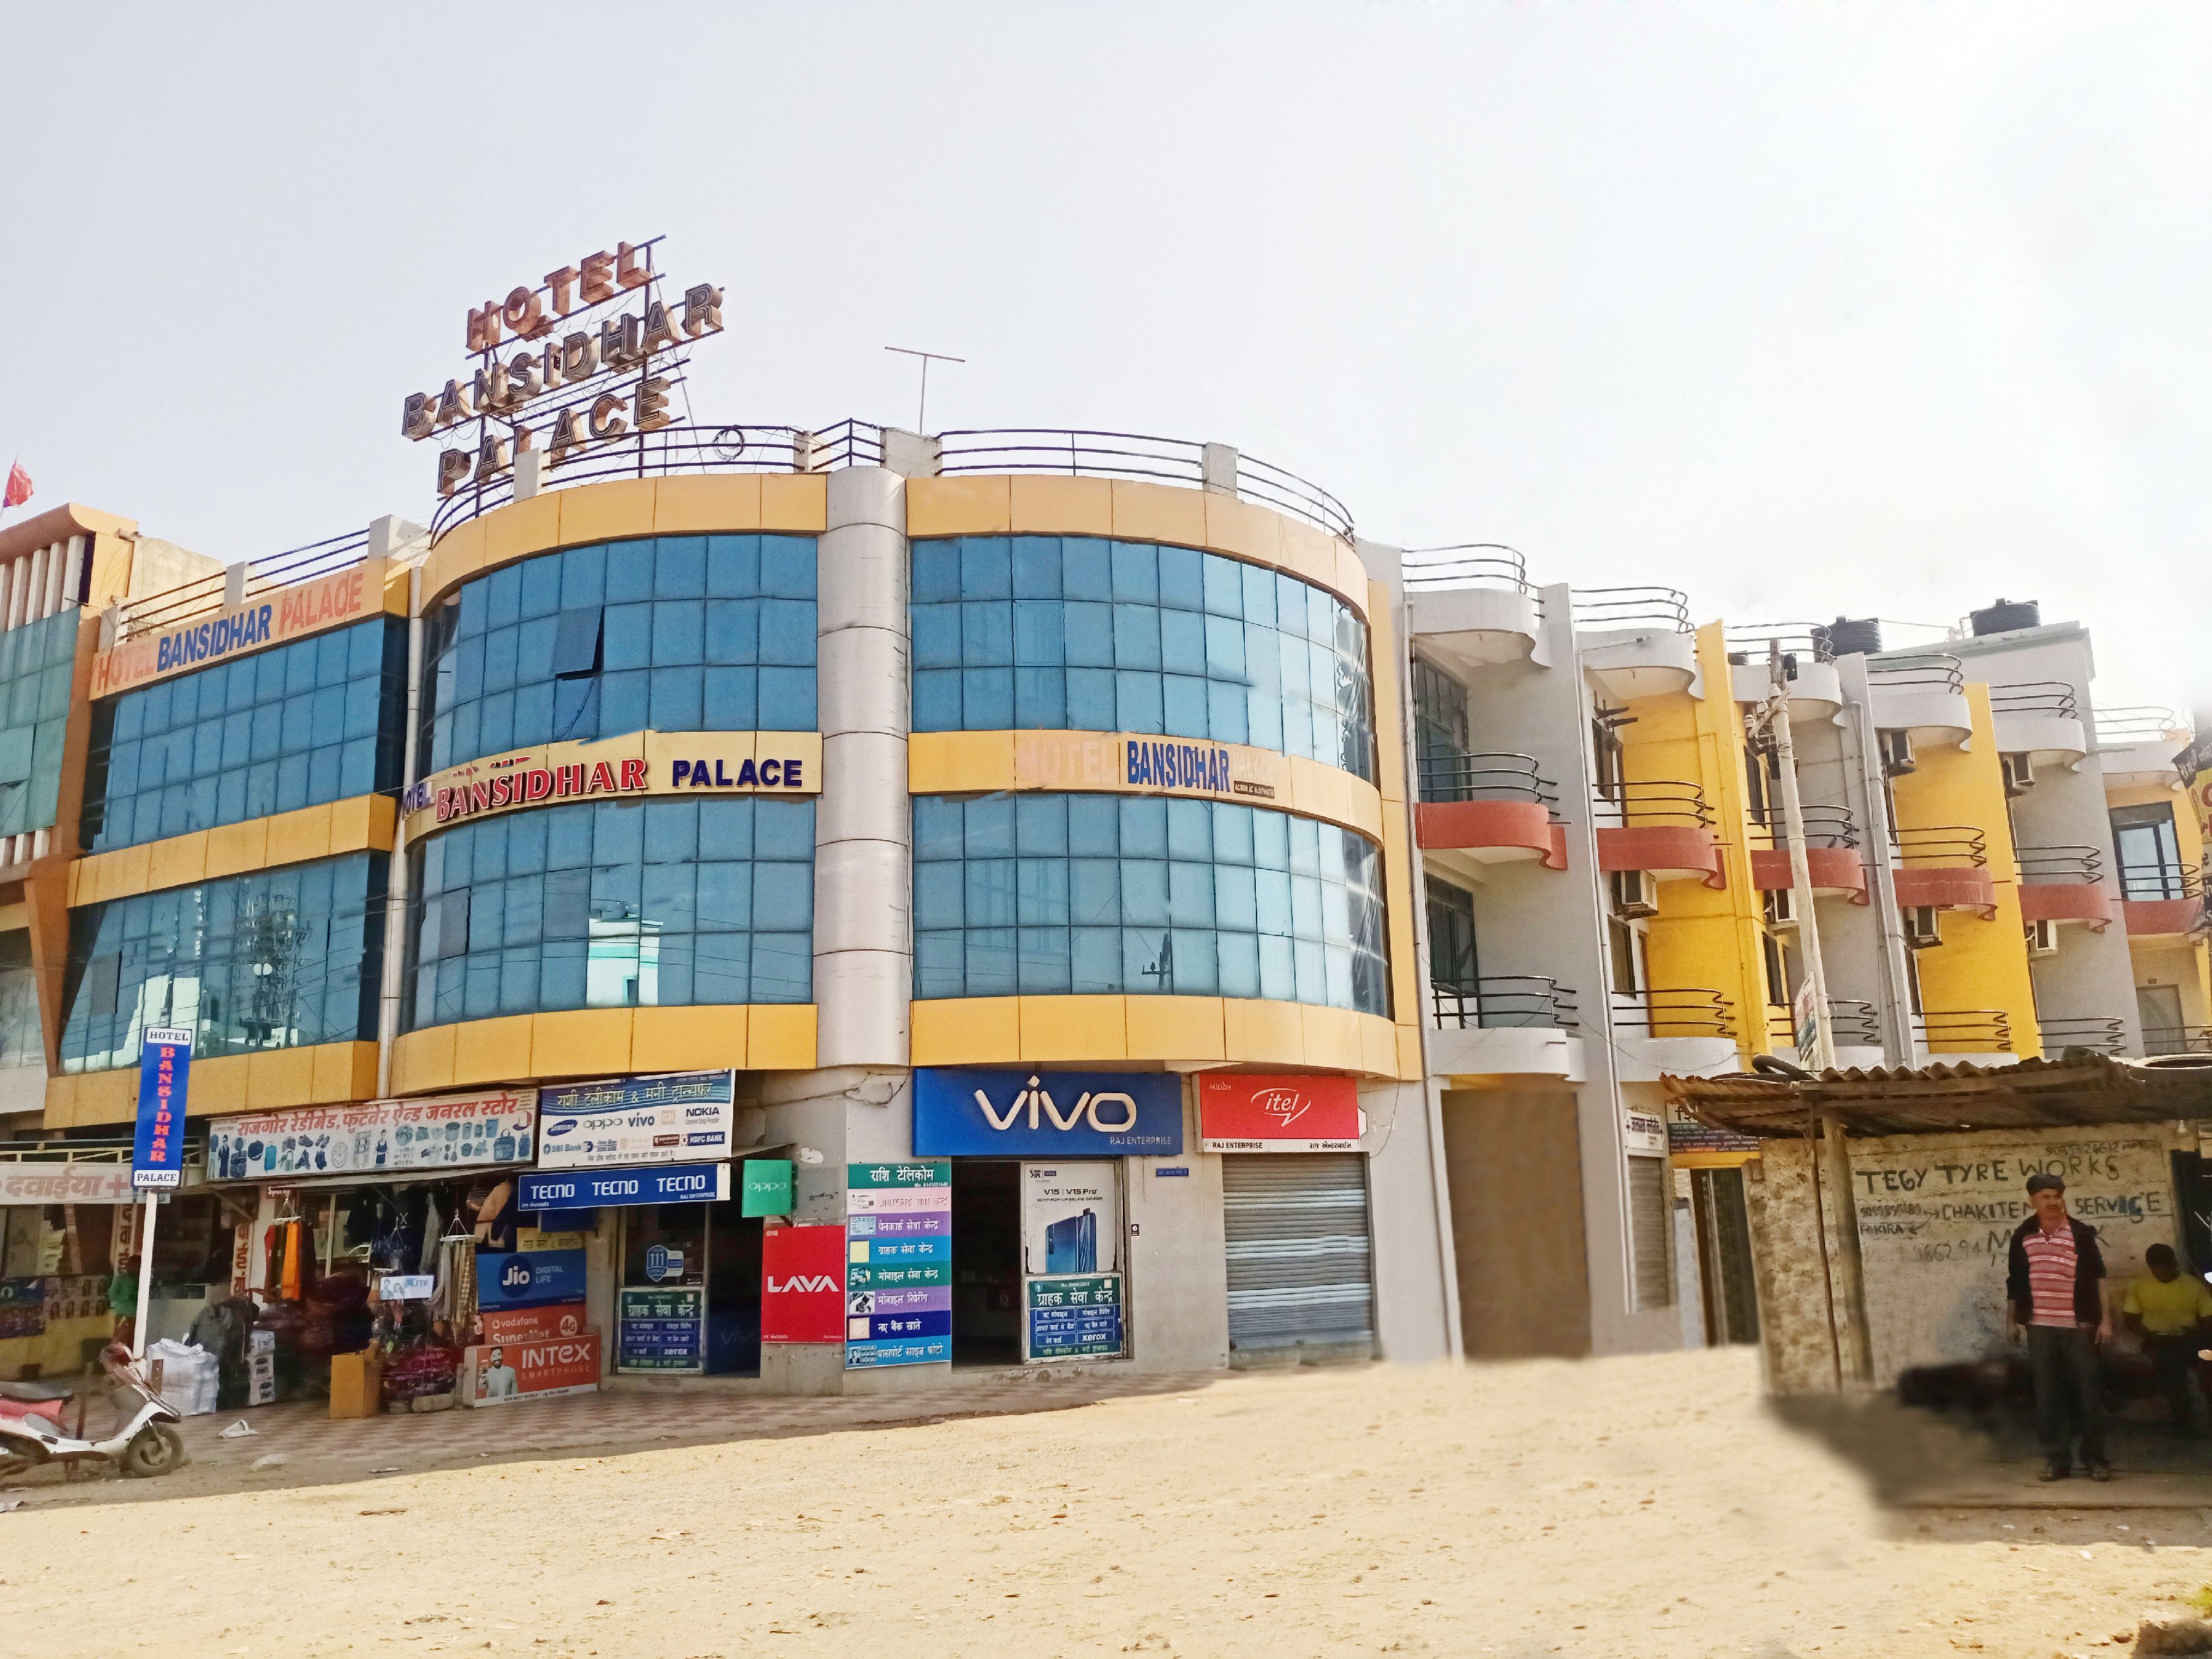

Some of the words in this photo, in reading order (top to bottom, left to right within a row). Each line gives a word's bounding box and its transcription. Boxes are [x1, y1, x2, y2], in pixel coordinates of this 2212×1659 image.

[466, 241, 652, 353] HOTEL
[402, 283, 724, 441] BANSIDHAR
[96, 642, 156, 691] HOTEL
[156, 604, 273, 673] BANSIDHAR
[278, 573, 364, 636] PALACE
[1127, 740, 1231, 793] BANSIDHAR
[436, 757, 648, 823] BANSIDHAR
[672, 758, 804, 788] PALACE
[150, 1031, 189, 1042] HOTEL
[632, 1091, 639, 1103] &
[645, 1081, 667, 1101] मनी
[149, 1047, 176, 1162] BANSIDHAR
[425, 1101, 479, 1121] जनरल
[481, 1092, 519, 1117] स्टोर
[973, 1075, 1137, 1132] vivo
[1265, 1093, 1300, 1111] itel
[686, 1106, 720, 1117] NOKIA
[583, 1118, 623, 1130] oppo
[628, 1112, 655, 1127] vivo
[706, 1134, 723, 1143] BANK
[1110, 1136, 1125, 1145] RAJ
[1127, 1136, 1172, 1145] ENTERPRISE
[551, 1144, 563, 1152] SBI
[565, 1143, 582, 1151] Bank
[136, 1173, 177, 1182] PALACE
[870, 1167, 890, 1182] राशि
[896, 1165, 935, 1182] टेलिकोम
[1855, 1168, 1927, 1194] TEGY
[1934, 1160, 2008, 1184] TYRE
[2018, 1155, 2120, 1180] WORKS
[592, 1180, 639, 1196] TECNO
[656, 1175, 706, 1192] TECNO
[748, 1182, 788, 1193] oppo
[530, 1184, 575, 1200] TECNO
[906, 1219, 922, 1230] सेवा
[924, 1218, 940, 1230] केन्द्र
[878, 1245, 899, 1255] ग्राहक
[901, 1242, 916, 1254] सेवा
[918, 1242, 933, 1254] केन्द्र
[650, 1253, 665, 1266] 111
[502, 1266, 530, 1286] Jio
[536, 1266, 564, 1274] DIGITAL
[907, 1268, 922, 1280] सेवा
[924, 1267, 938, 1279] केन्द्र
[768, 1275, 840, 1293] LAVA
[1036, 1292, 1064, 1306] ग्राहक
[1070, 1287, 1089, 1304] सेवा
[1094, 1286, 1113, 1304] केन्द्र
[628, 1304, 650, 1317] ग्राहक
[654, 1300, 671, 1317] सेवा
[677, 1299, 695, 1317] केन्द्र
[501, 1317, 538, 1327] vodafone
[562, 1319, 575, 1333] 4G
[905, 1318, 923, 1330] खाते
[1082, 1333, 1106, 1341] xerox
[927, 1342, 944, 1355] फोटो
[522, 1365, 592, 1380] SMARTPHONE
